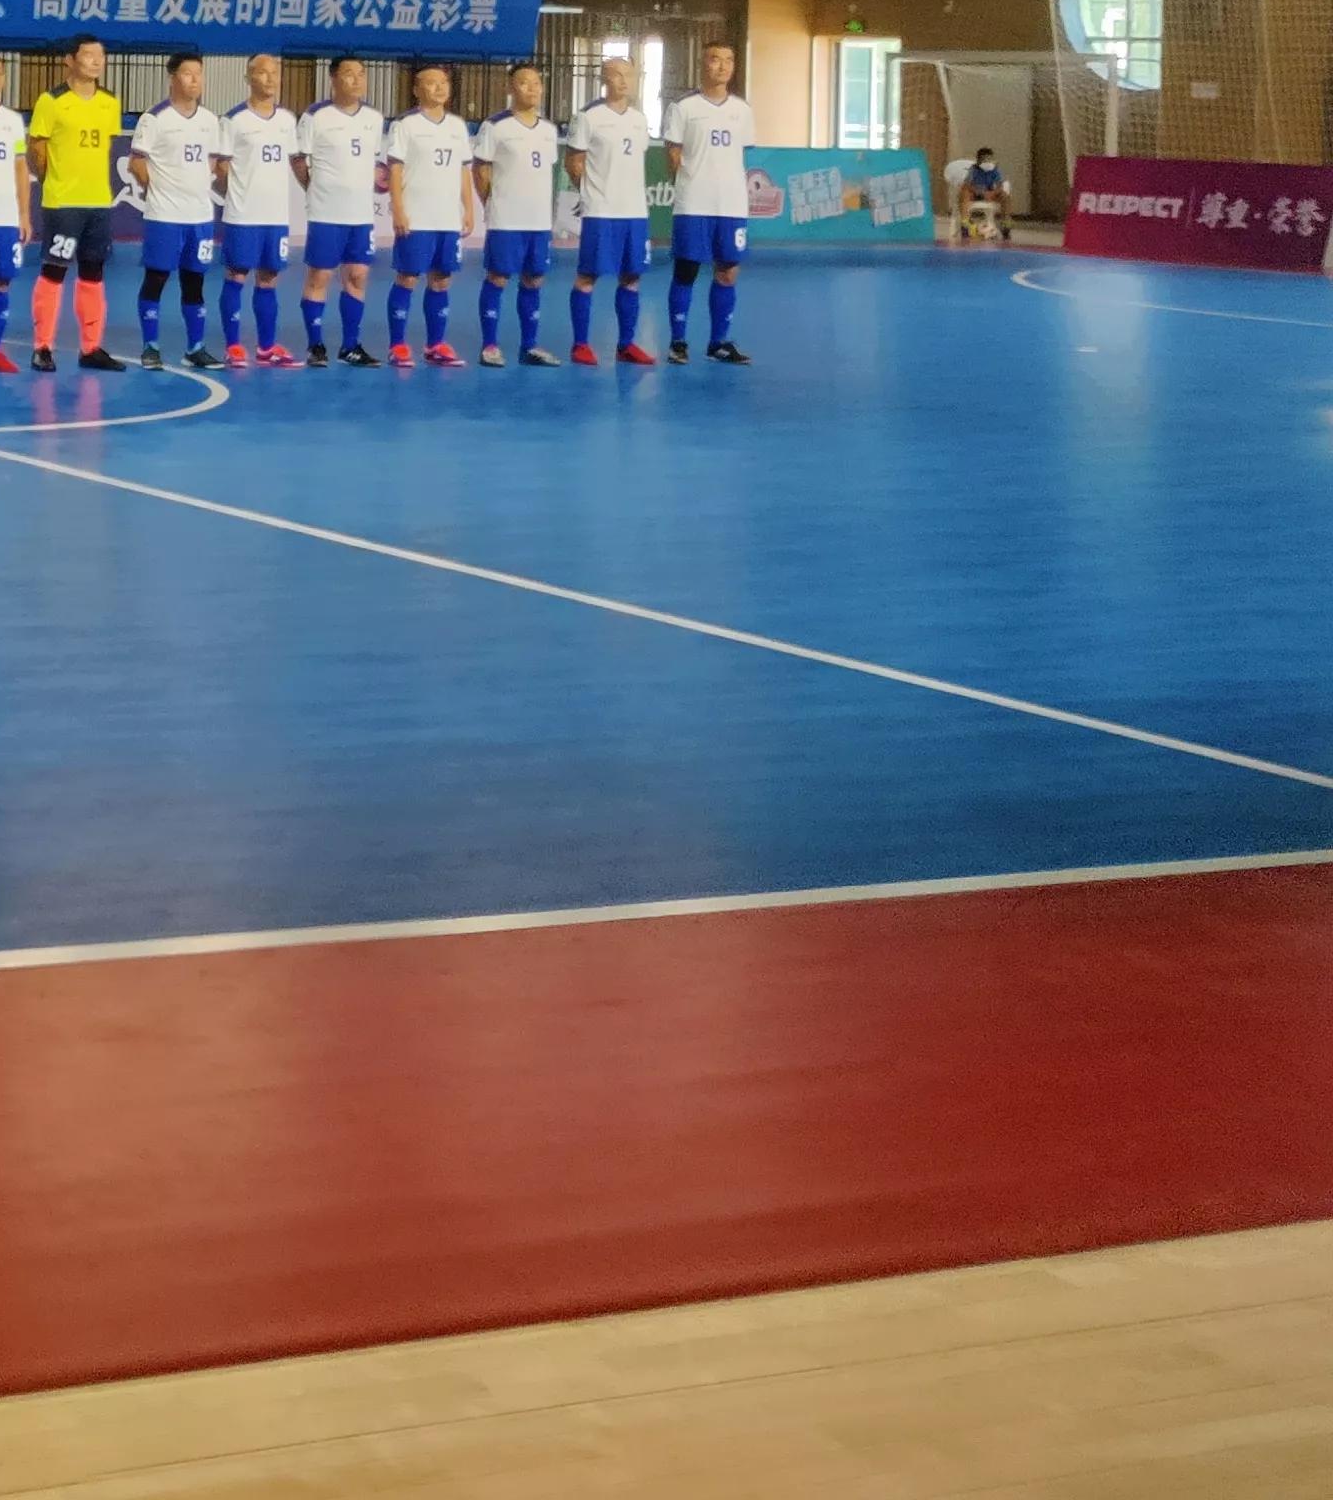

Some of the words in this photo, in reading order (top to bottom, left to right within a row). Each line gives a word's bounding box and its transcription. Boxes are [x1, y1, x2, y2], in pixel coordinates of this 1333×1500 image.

[78, 129, 101, 149] 29
[350, 138, 362, 157] 5
[622, 137, 633, 156] 2
[710, 129, 731, 148] 60
[183, 144, 203, 163] 62
[261, 144, 282, 163] 63
[433, 148, 453, 167] 37
[531, 150, 542, 169] 8
[1078, 191, 1183, 219] RESPECT
[48, 234, 77, 260] 29
